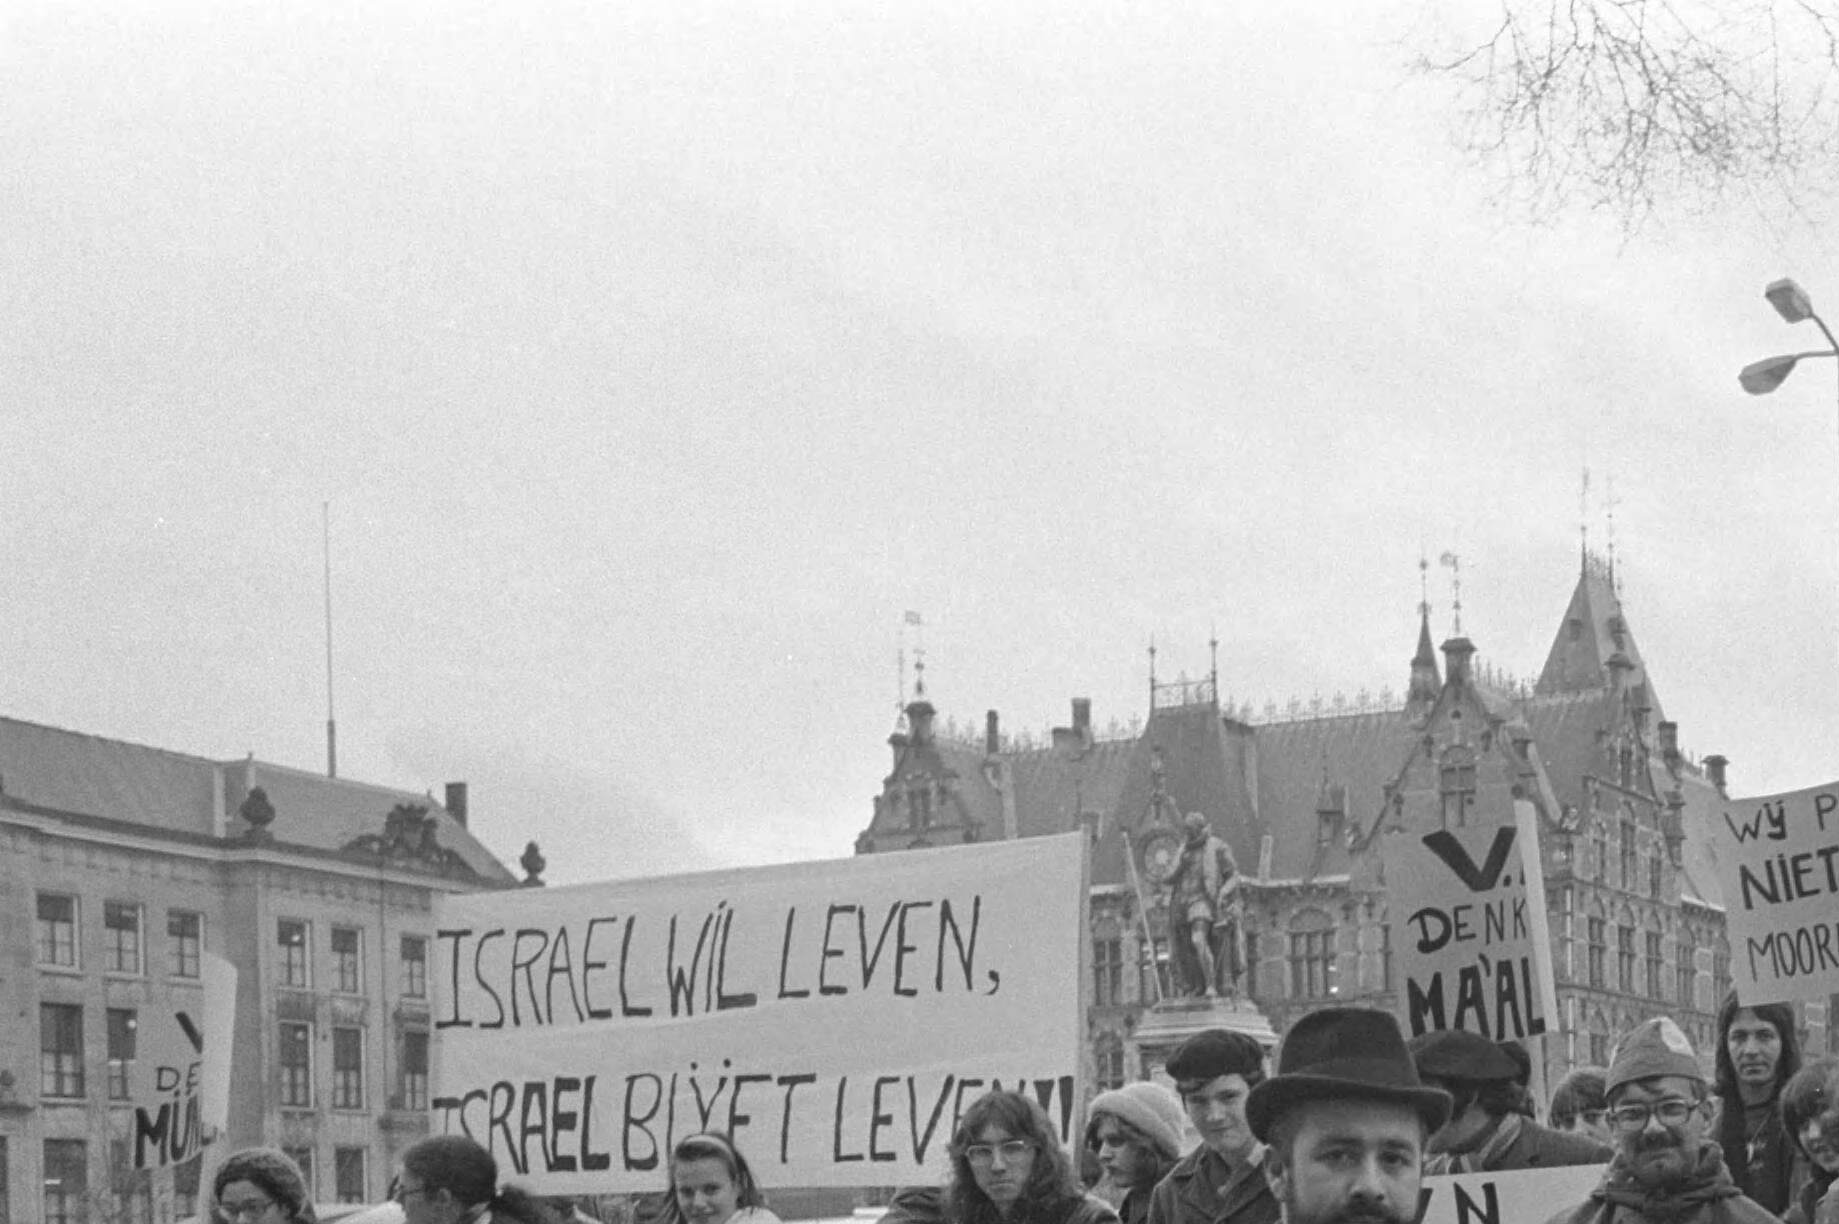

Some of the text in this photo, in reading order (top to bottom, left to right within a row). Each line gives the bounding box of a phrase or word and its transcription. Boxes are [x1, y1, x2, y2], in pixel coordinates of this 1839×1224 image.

[435, 916, 652, 1030] ISRAEL
[777, 896, 1000, 997] LEVEN,
[1407, 898, 1527, 954] DENK
